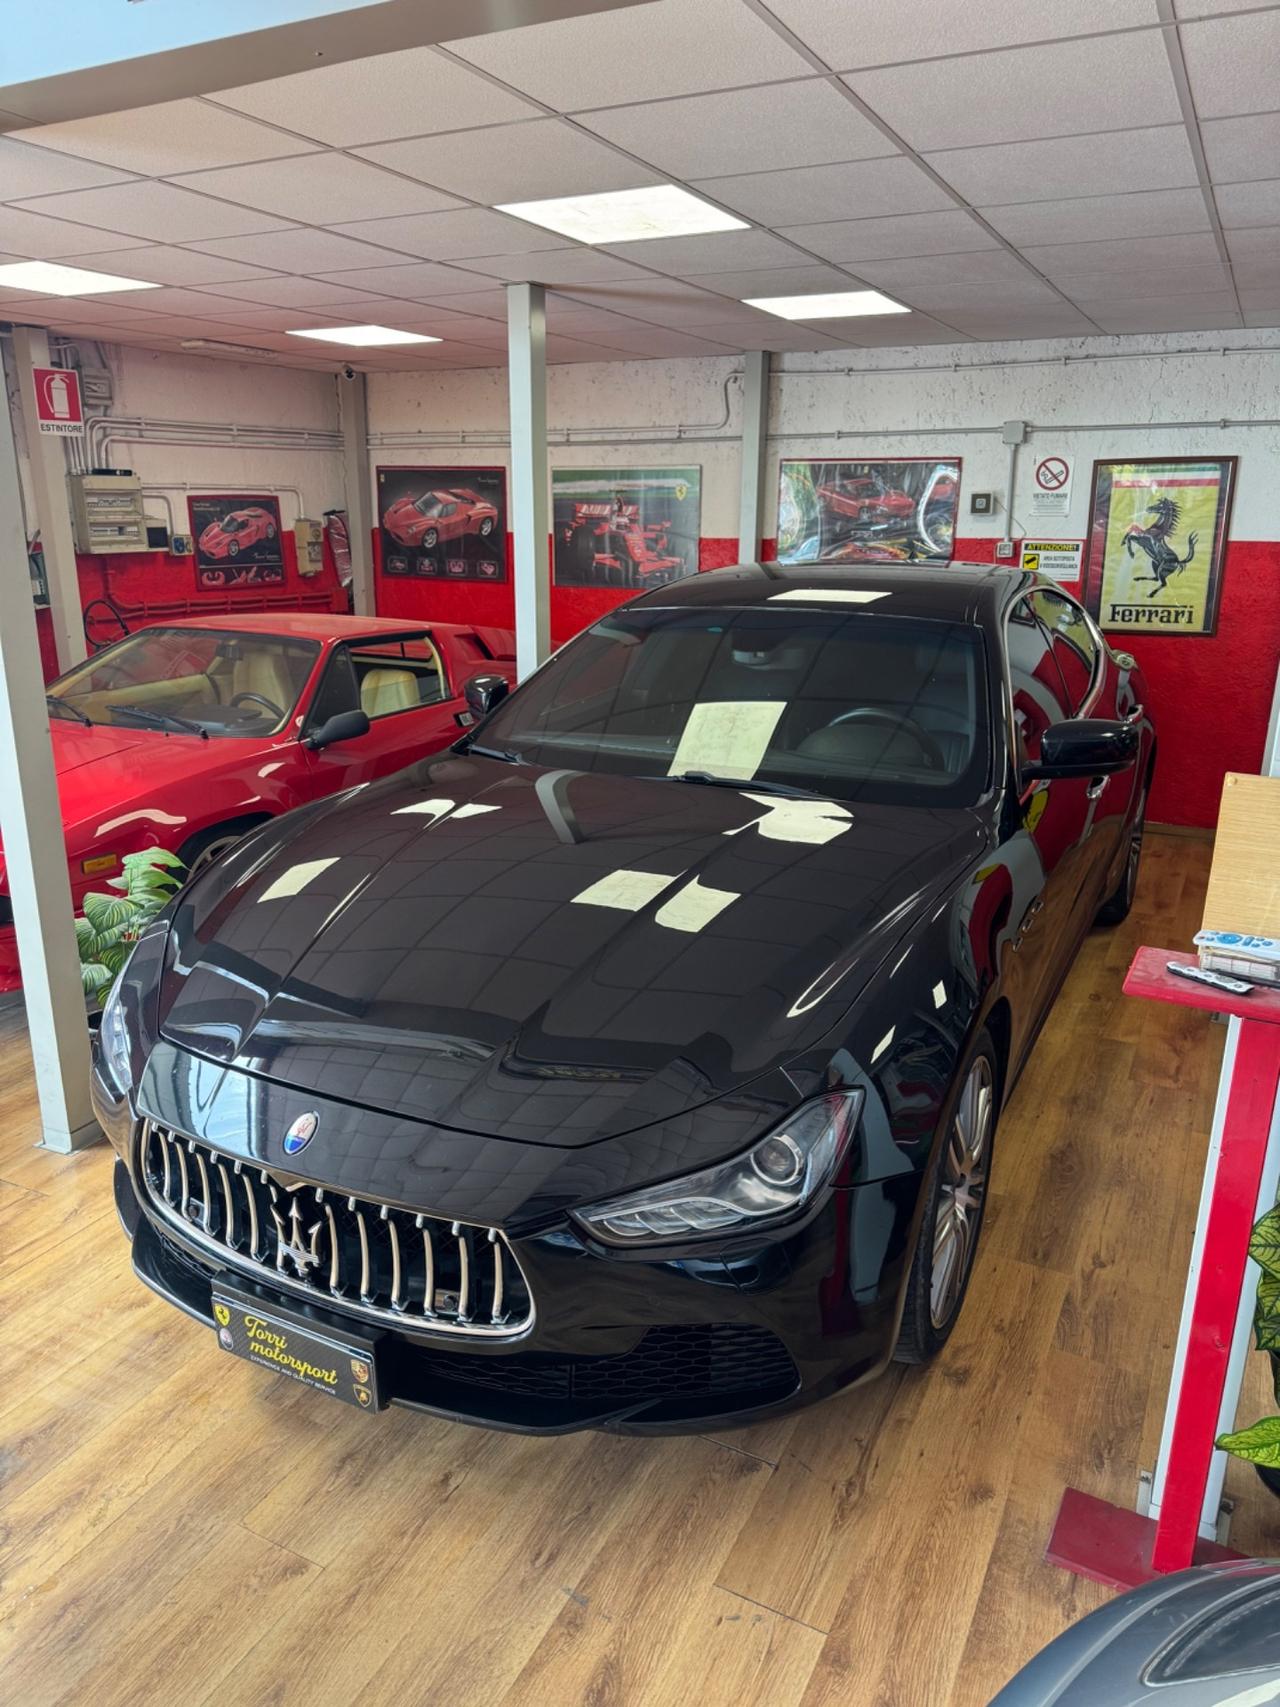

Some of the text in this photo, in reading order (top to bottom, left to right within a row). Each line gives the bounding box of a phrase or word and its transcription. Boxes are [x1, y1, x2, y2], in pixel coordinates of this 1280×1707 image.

[40, 423, 83, 433] ESTINTORE
[1027, 543, 1076, 551] ATTENZIONE!
[1108, 604, 1194, 624] Ferrari
[244, 1315, 288, 1349] Torri
[250, 1341, 338, 1385] motorsport
[281, 1368, 292, 1376] AND
[292, 1372, 314, 1386] QUALITY
